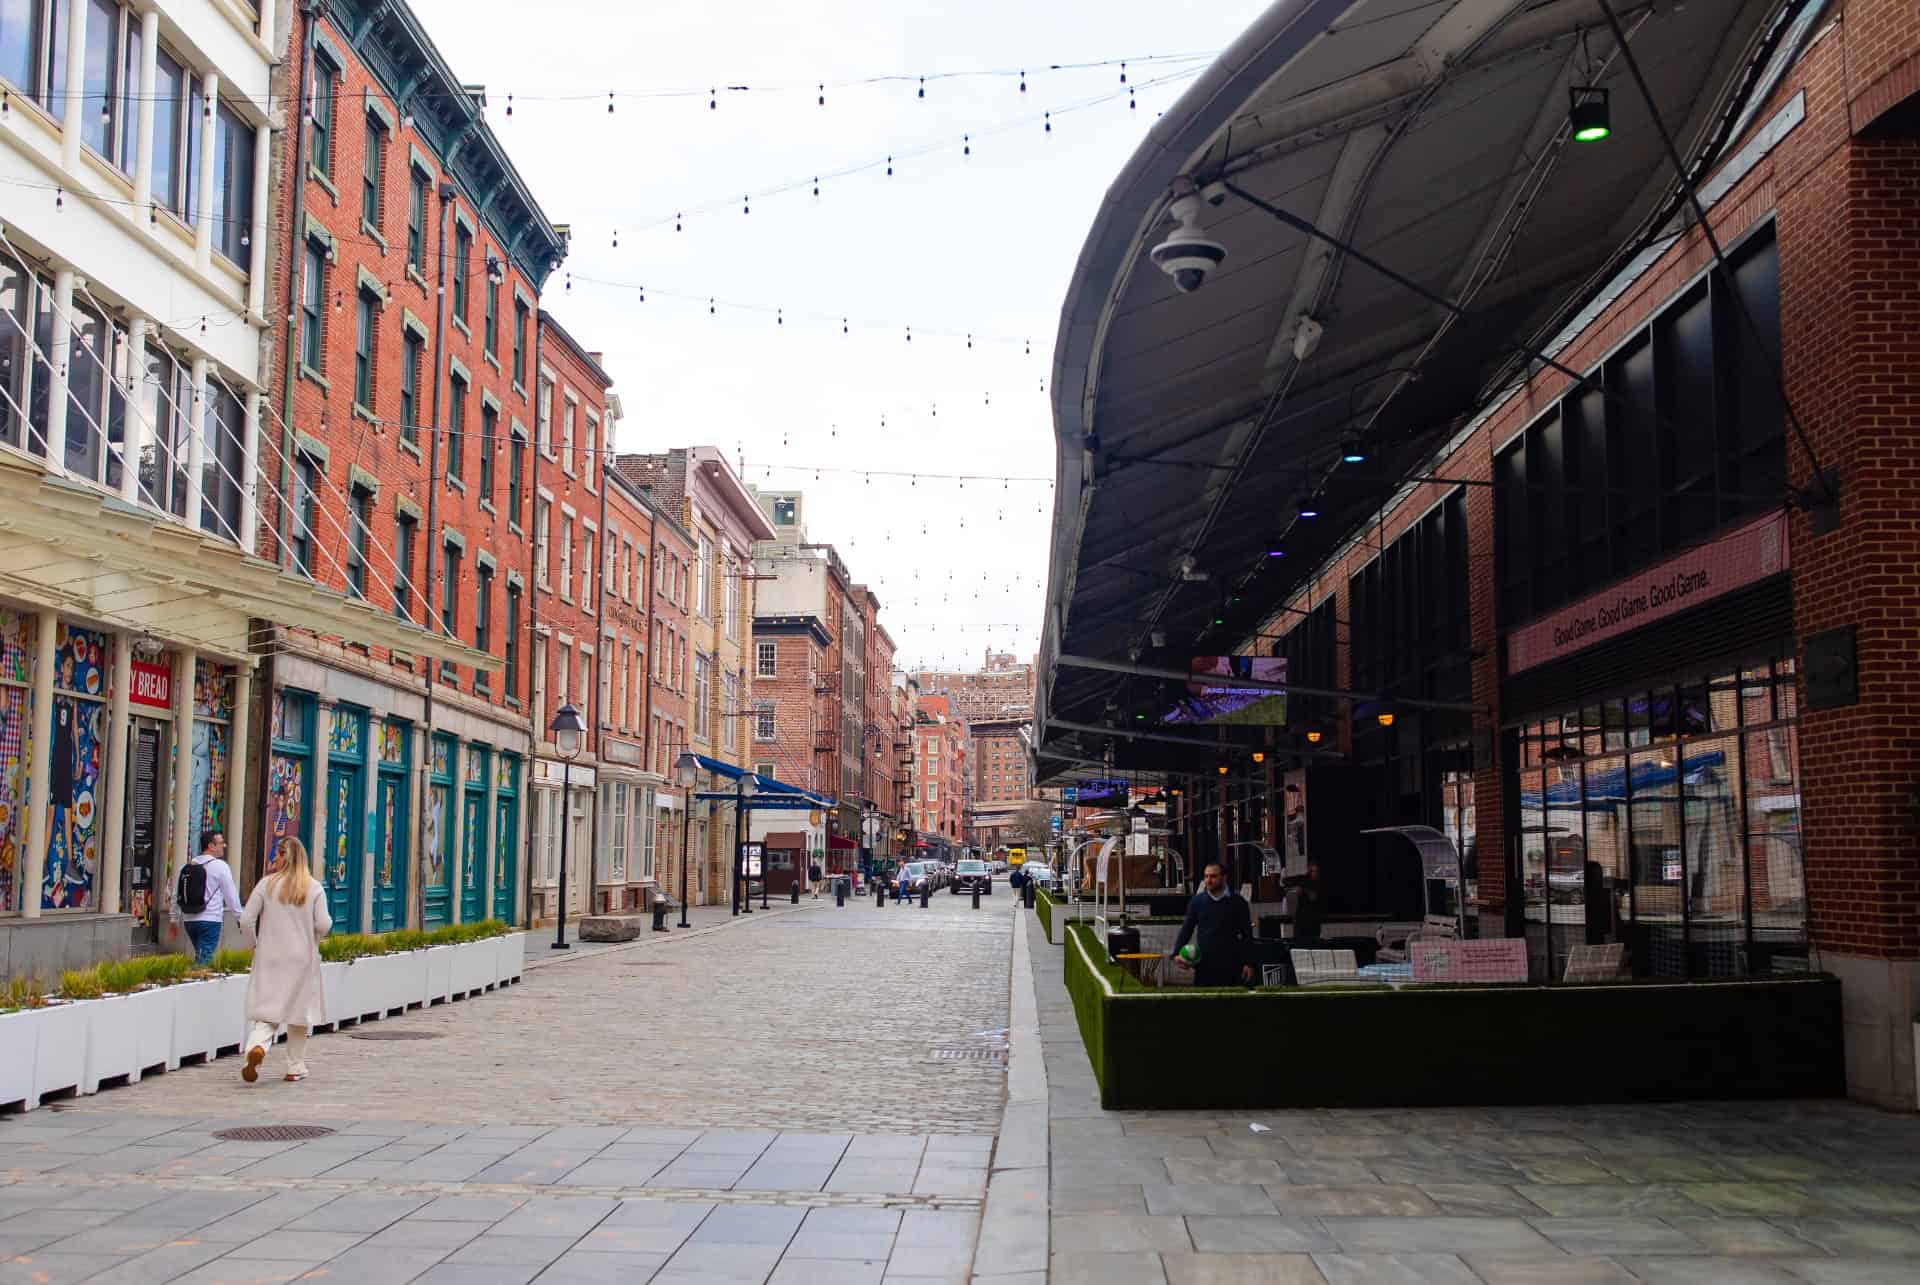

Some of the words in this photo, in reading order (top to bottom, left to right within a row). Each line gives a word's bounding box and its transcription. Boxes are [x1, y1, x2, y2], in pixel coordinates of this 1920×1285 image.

[1555, 623, 1573, 646] Good
[1599, 600, 1620, 627] Good
[1650, 576, 1675, 607] Good
[1677, 570, 1709, 596] Game.
[138, 671, 168, 701] BREAD
[61, 710, 67, 726] 9
